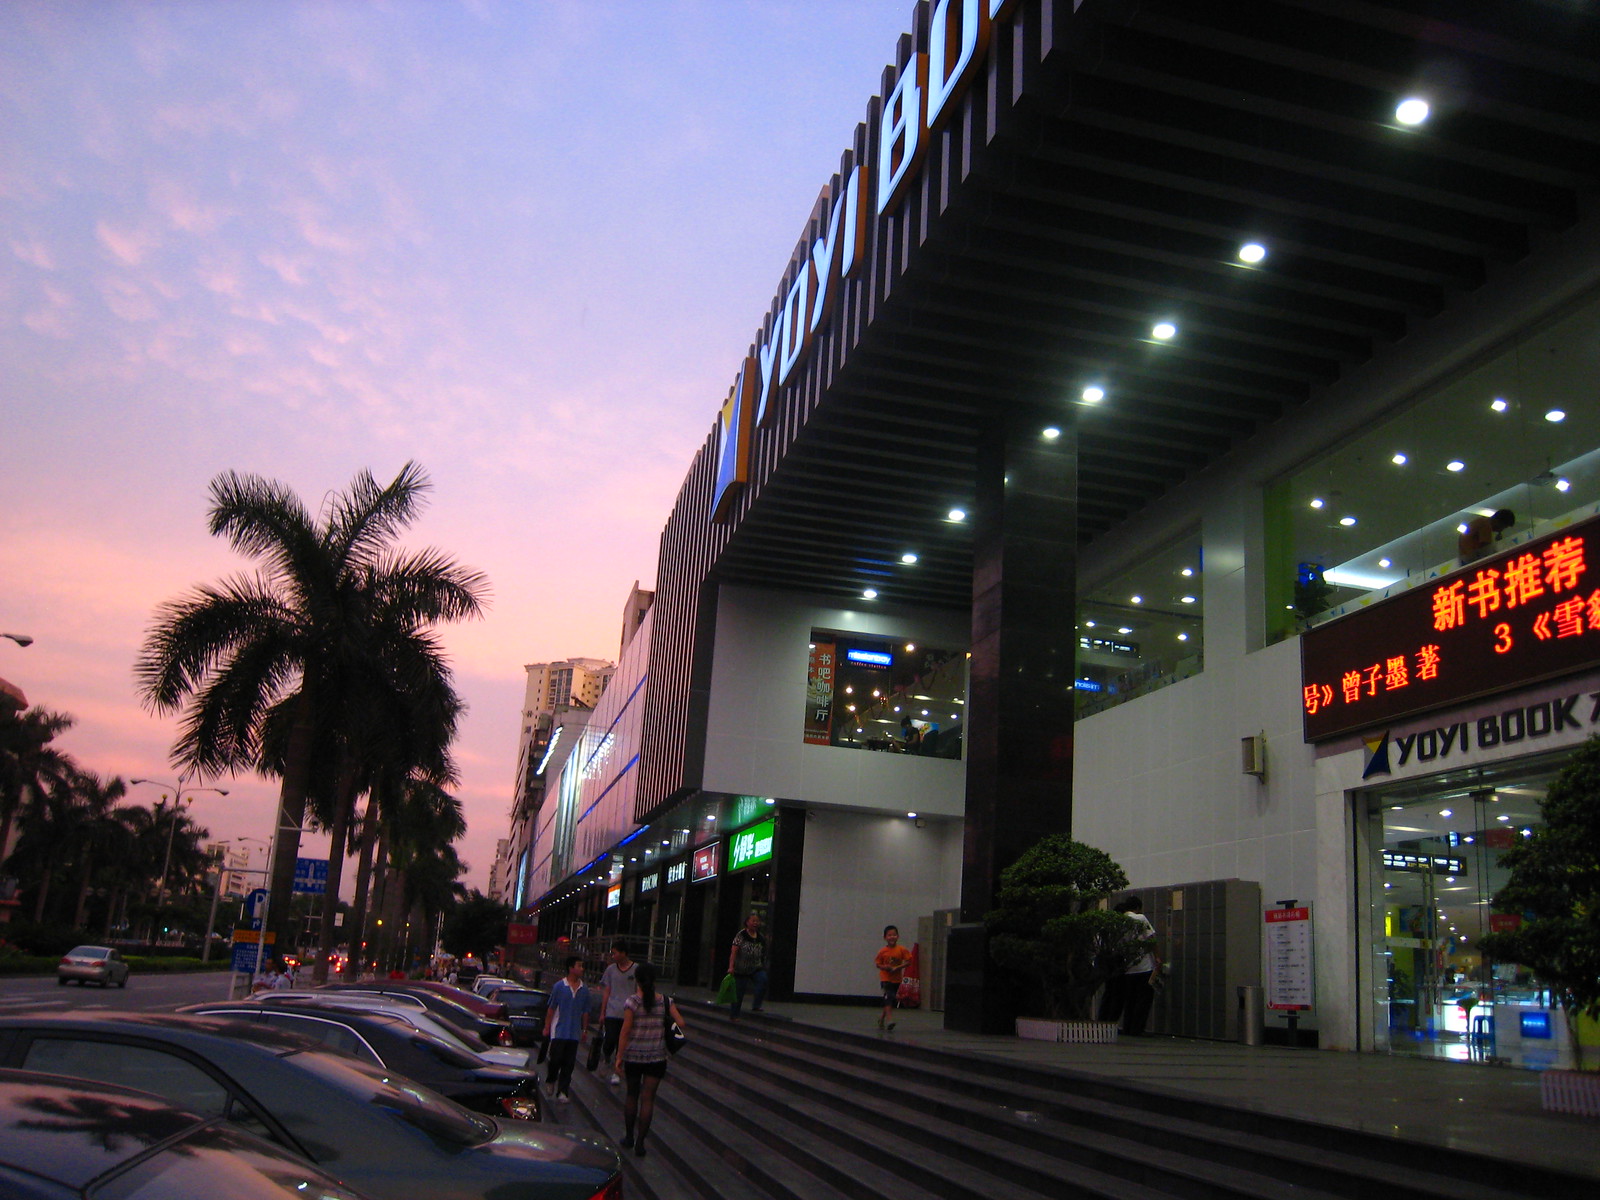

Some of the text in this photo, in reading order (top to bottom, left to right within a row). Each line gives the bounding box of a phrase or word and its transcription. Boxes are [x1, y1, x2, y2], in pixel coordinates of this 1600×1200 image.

[756, 0, 1004, 428] YOYI BO
[1432, 536, 1587, 631] 新书推荐
[814, 652, 832, 722] 书吧咖啡厅
[1414, 644, 1441, 681] 著
[1493, 622, 1514, 654] 3
[1395, 721, 1469, 765] YOYI
[1477, 693, 1582, 749] BOOK
